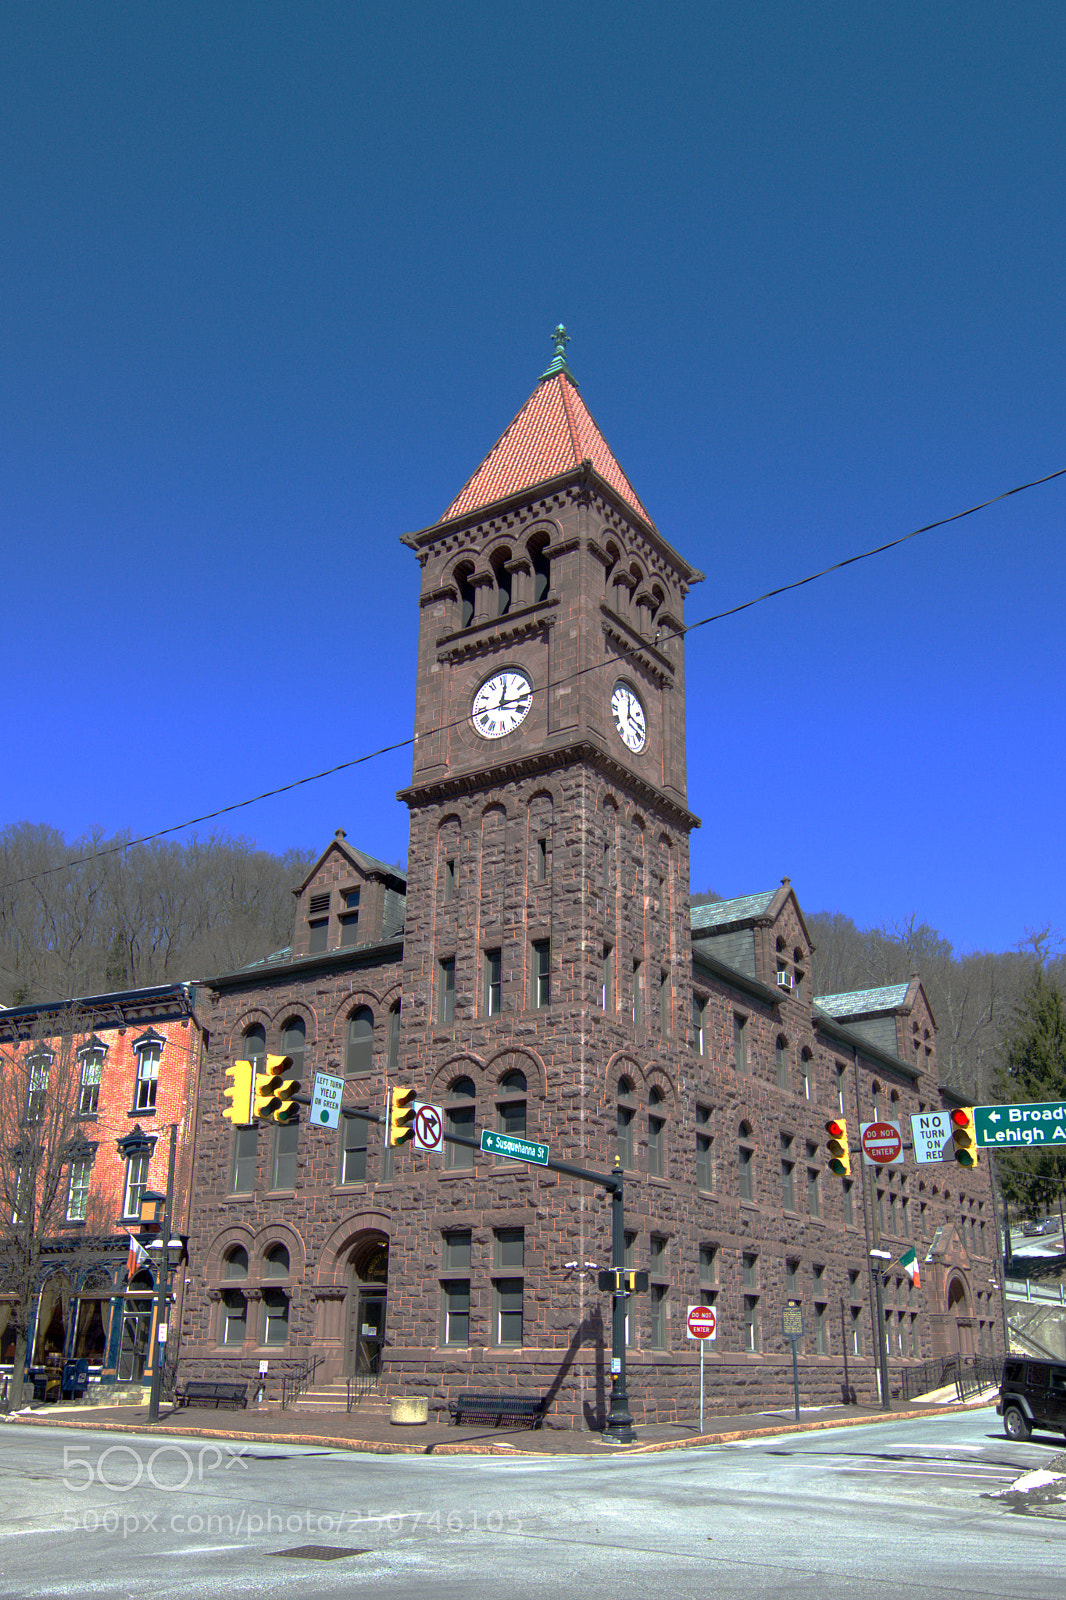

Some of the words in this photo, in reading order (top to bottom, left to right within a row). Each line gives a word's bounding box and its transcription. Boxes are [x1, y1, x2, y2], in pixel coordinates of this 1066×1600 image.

[316, 1076, 329, 1086] LEFT
[330, 1080, 342, 1089] TURN
[320, 1087, 336, 1099] YIELD
[322, 1100, 338, 1110] GREEN
[1009, 1106, 1066, 1122] Broad
[920, 1116, 941, 1129] NO
[920, 1129, 945, 1139] TURN
[983, 1127, 1045, 1145] Lehigh
[1052, 1126, 1066, 1139] A
[495, 1136, 535, 1157] Susquehanna
[537, 1146, 544, 1159] St
[927, 1140, 941, 1149] ON
[871, 1148, 895, 1157] ENTER
[926, 1150, 944, 1160] RED
